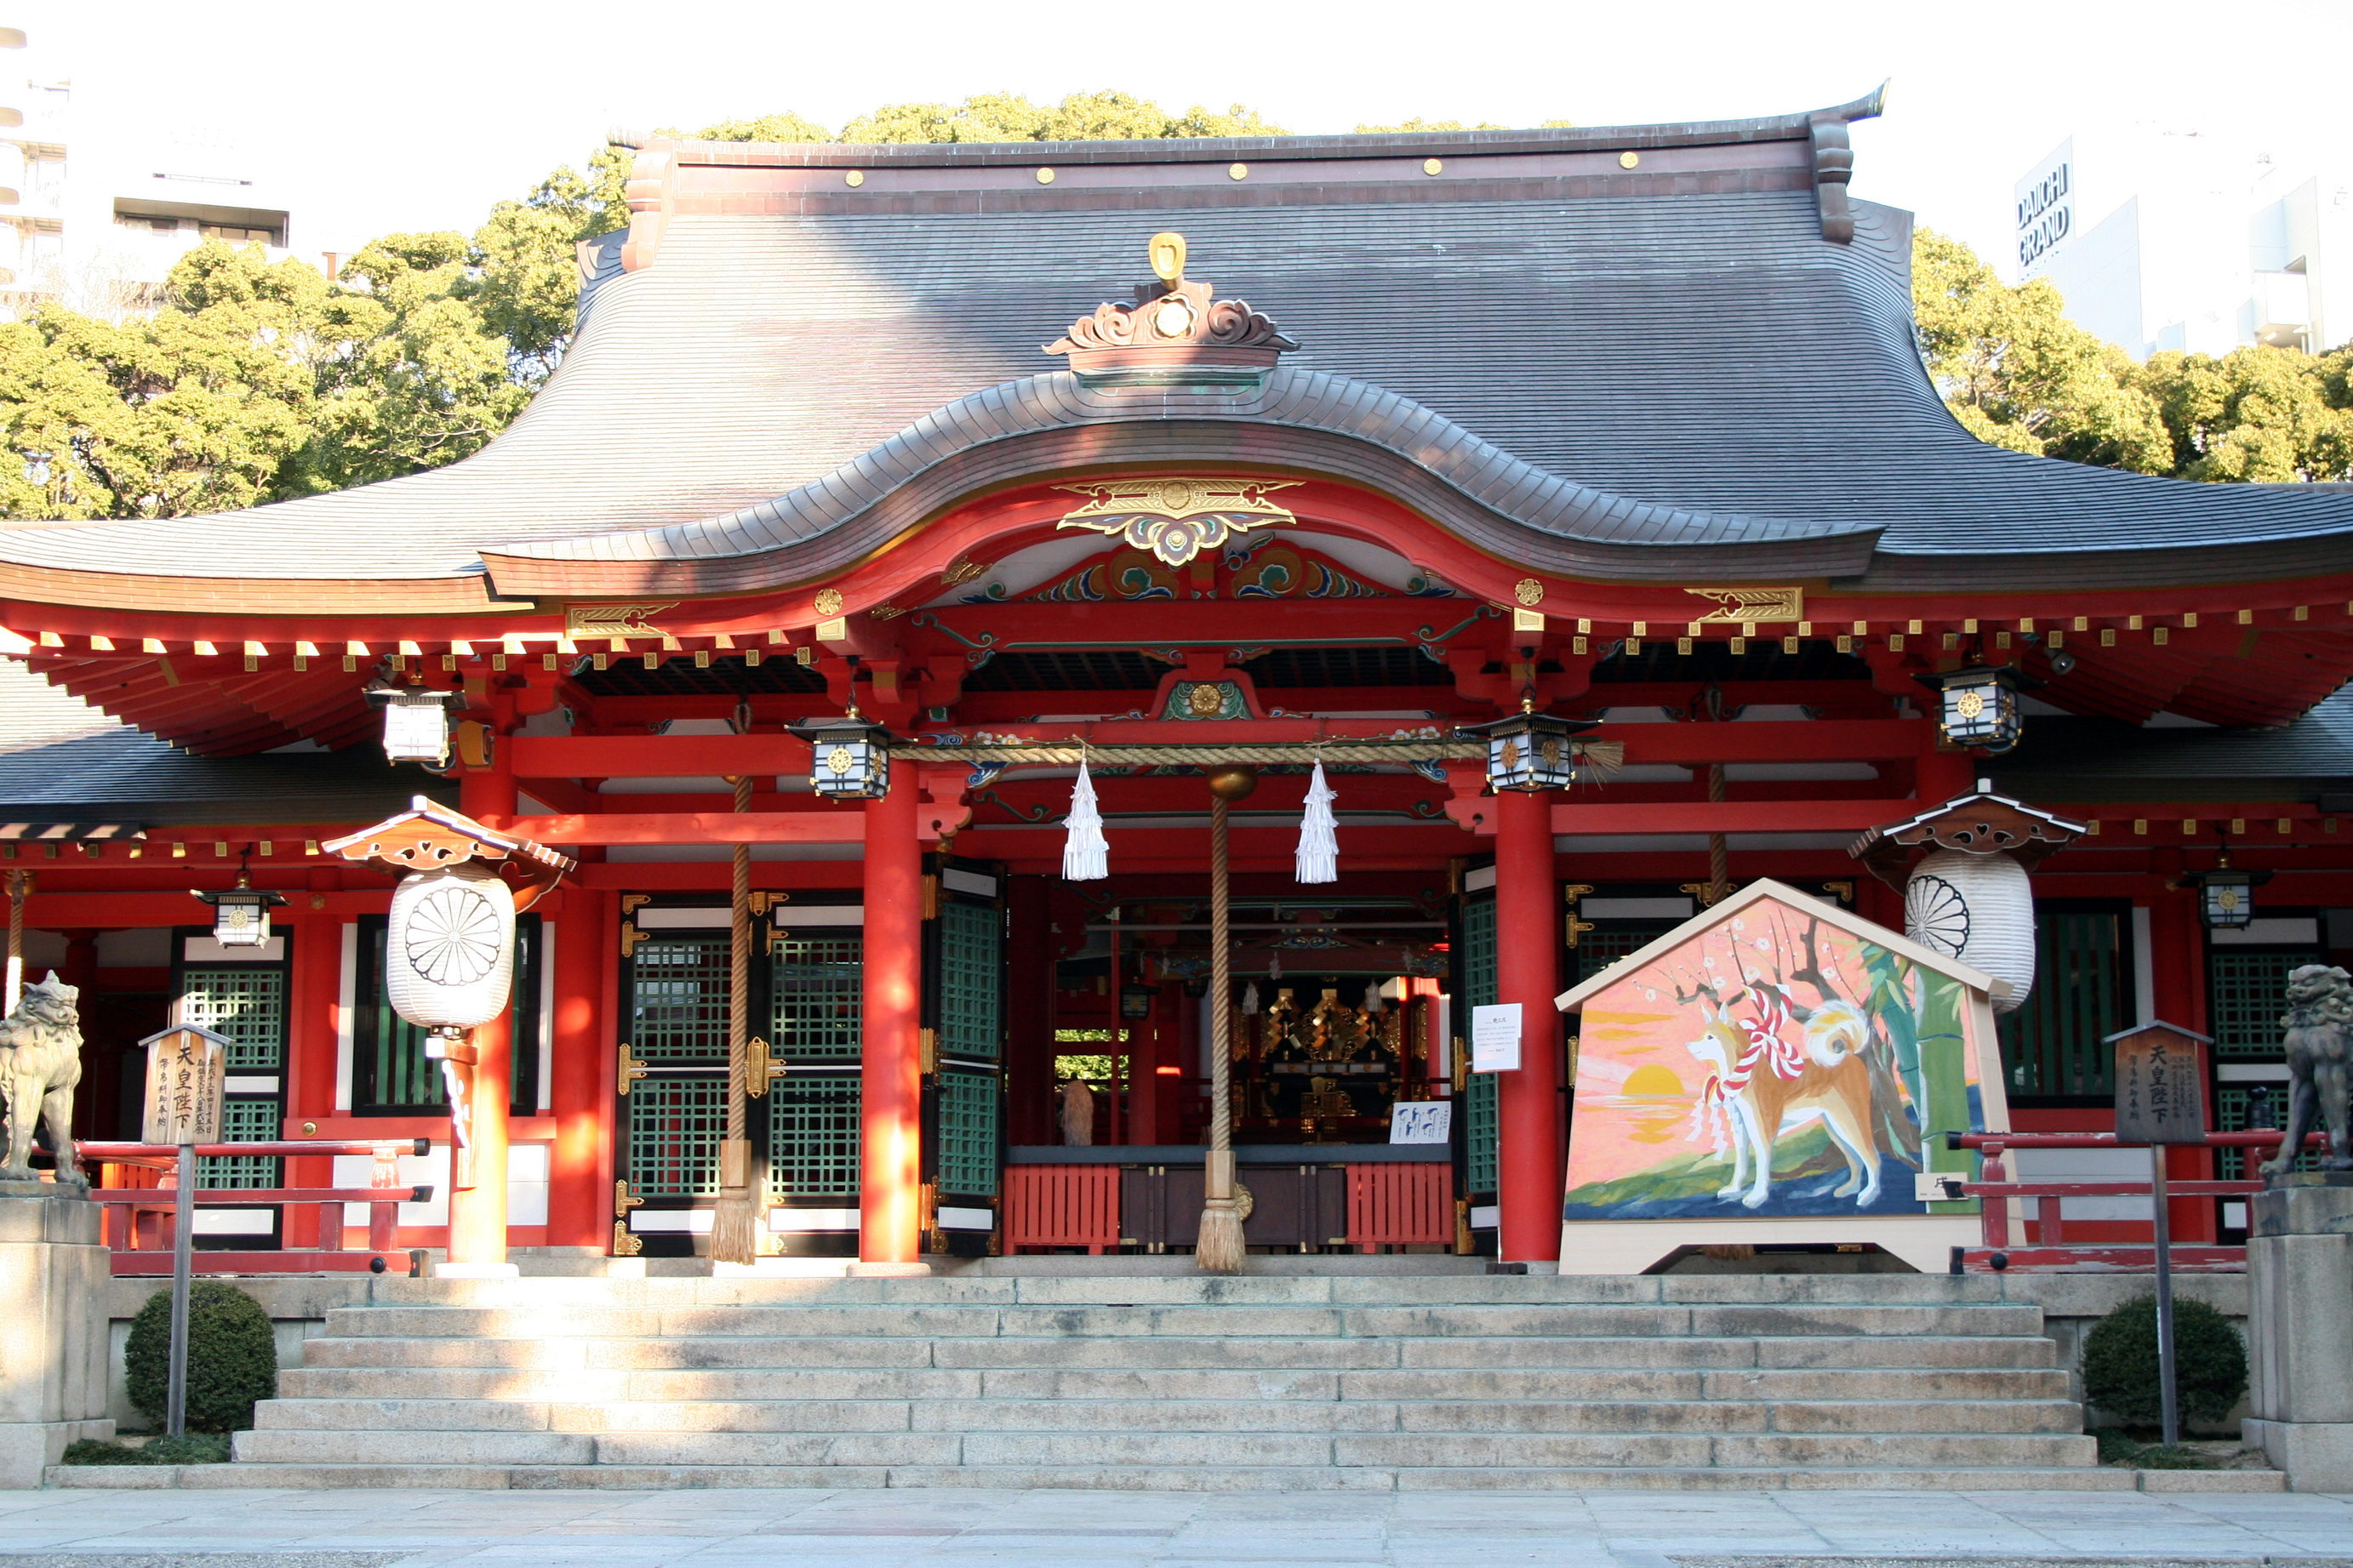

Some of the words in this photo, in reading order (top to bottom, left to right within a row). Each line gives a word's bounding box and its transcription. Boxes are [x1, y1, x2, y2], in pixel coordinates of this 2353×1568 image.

[2019, 206, 2070, 267] GRAND
[174, 1046, 194, 1129] 天皇陛下
[2149, 1045, 2168, 1124] 天皇陛下
